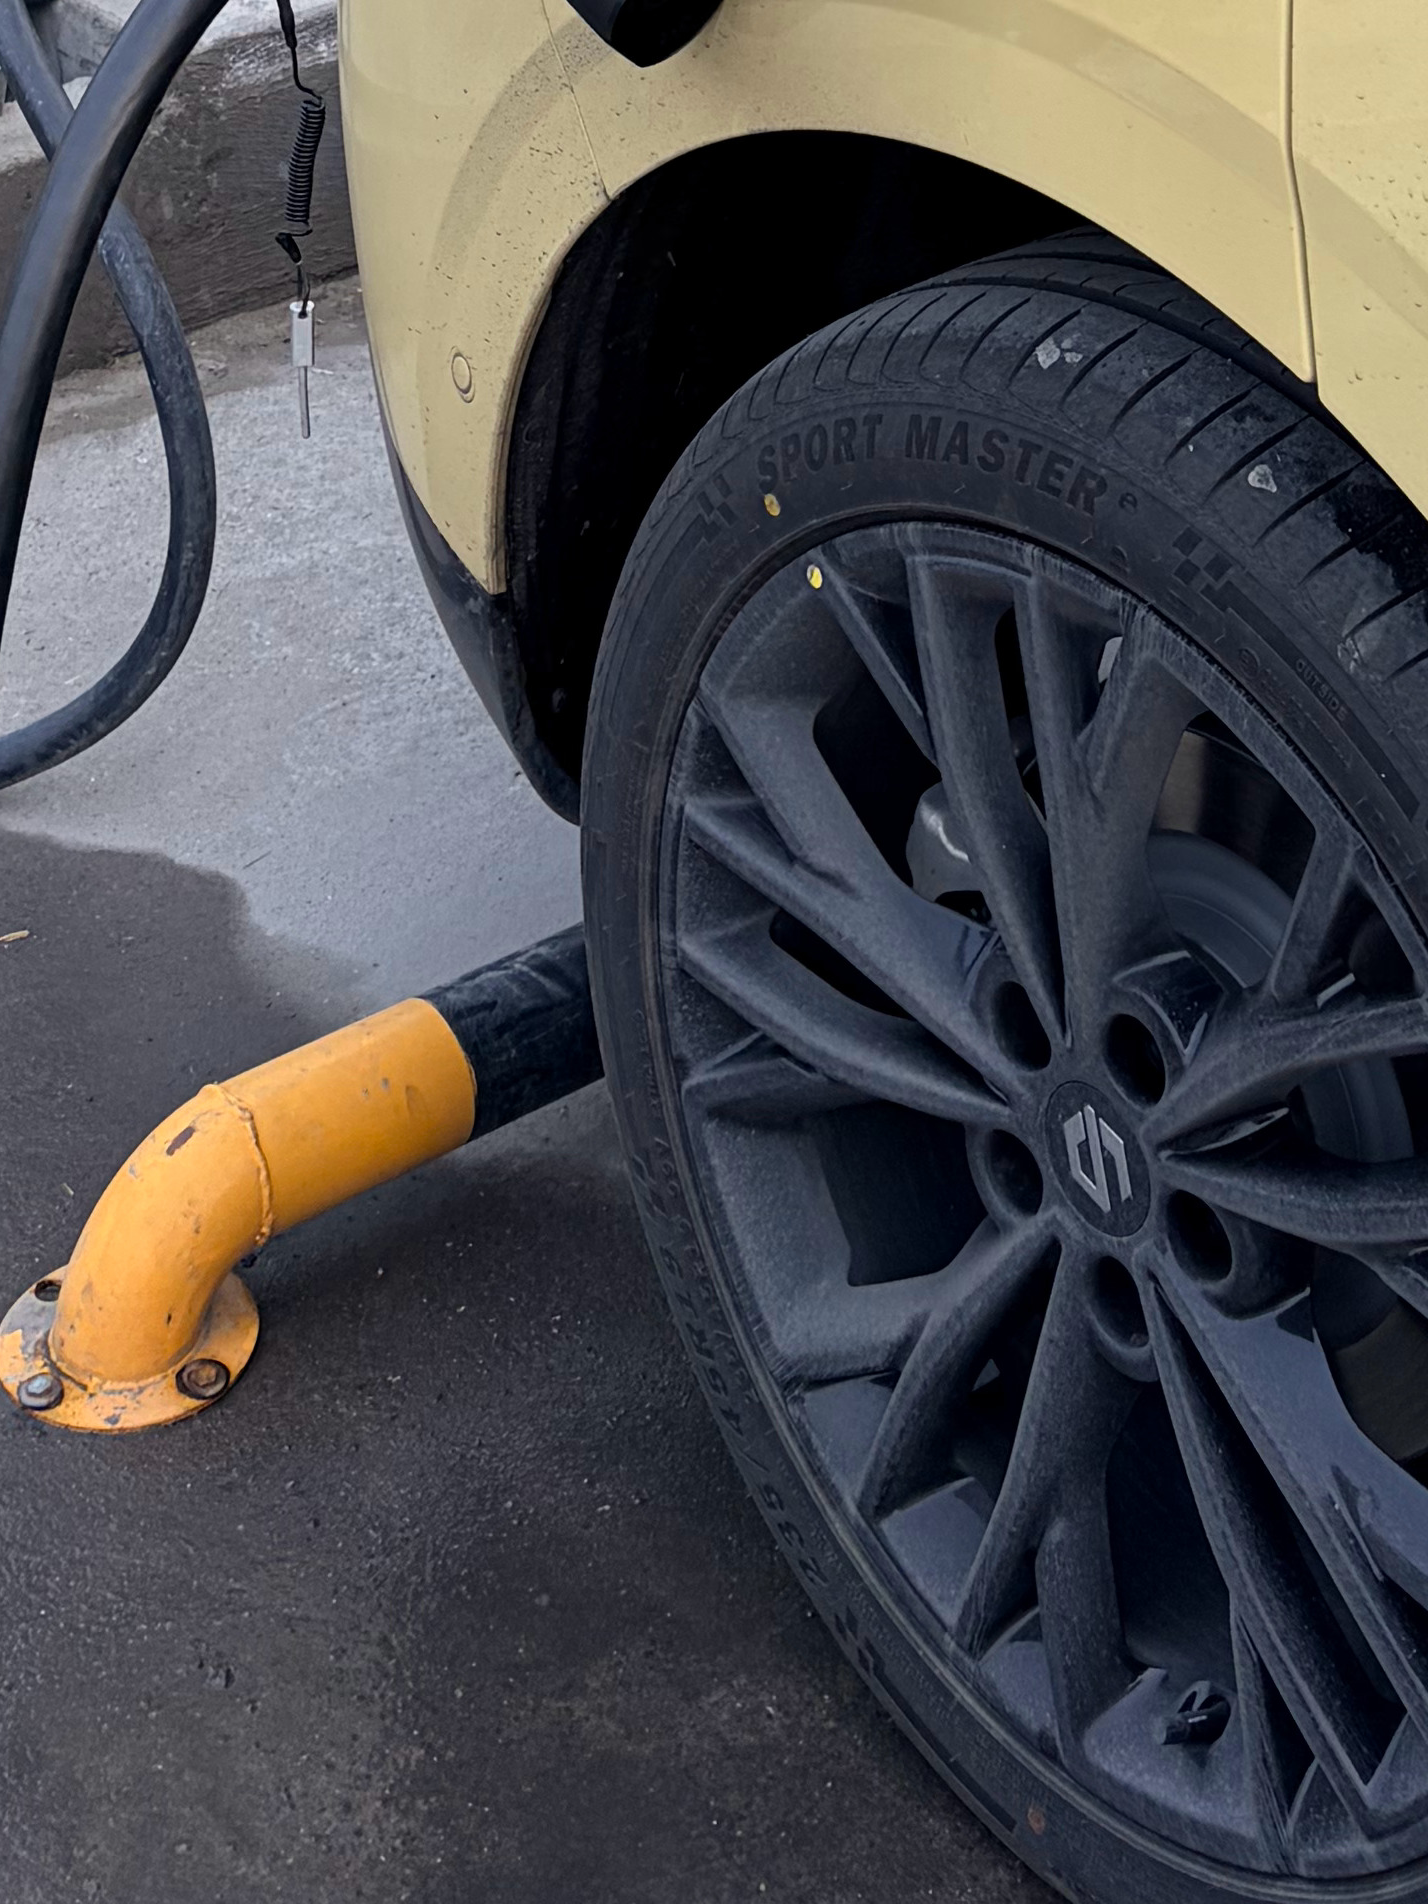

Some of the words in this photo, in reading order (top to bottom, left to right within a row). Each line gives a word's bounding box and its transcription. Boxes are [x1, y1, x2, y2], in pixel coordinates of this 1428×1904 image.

[756, 413, 884, 493] SPORT
[904, 413, 1109, 517] MASTER
[1294, 657, 1349, 722] OUTSIDE
